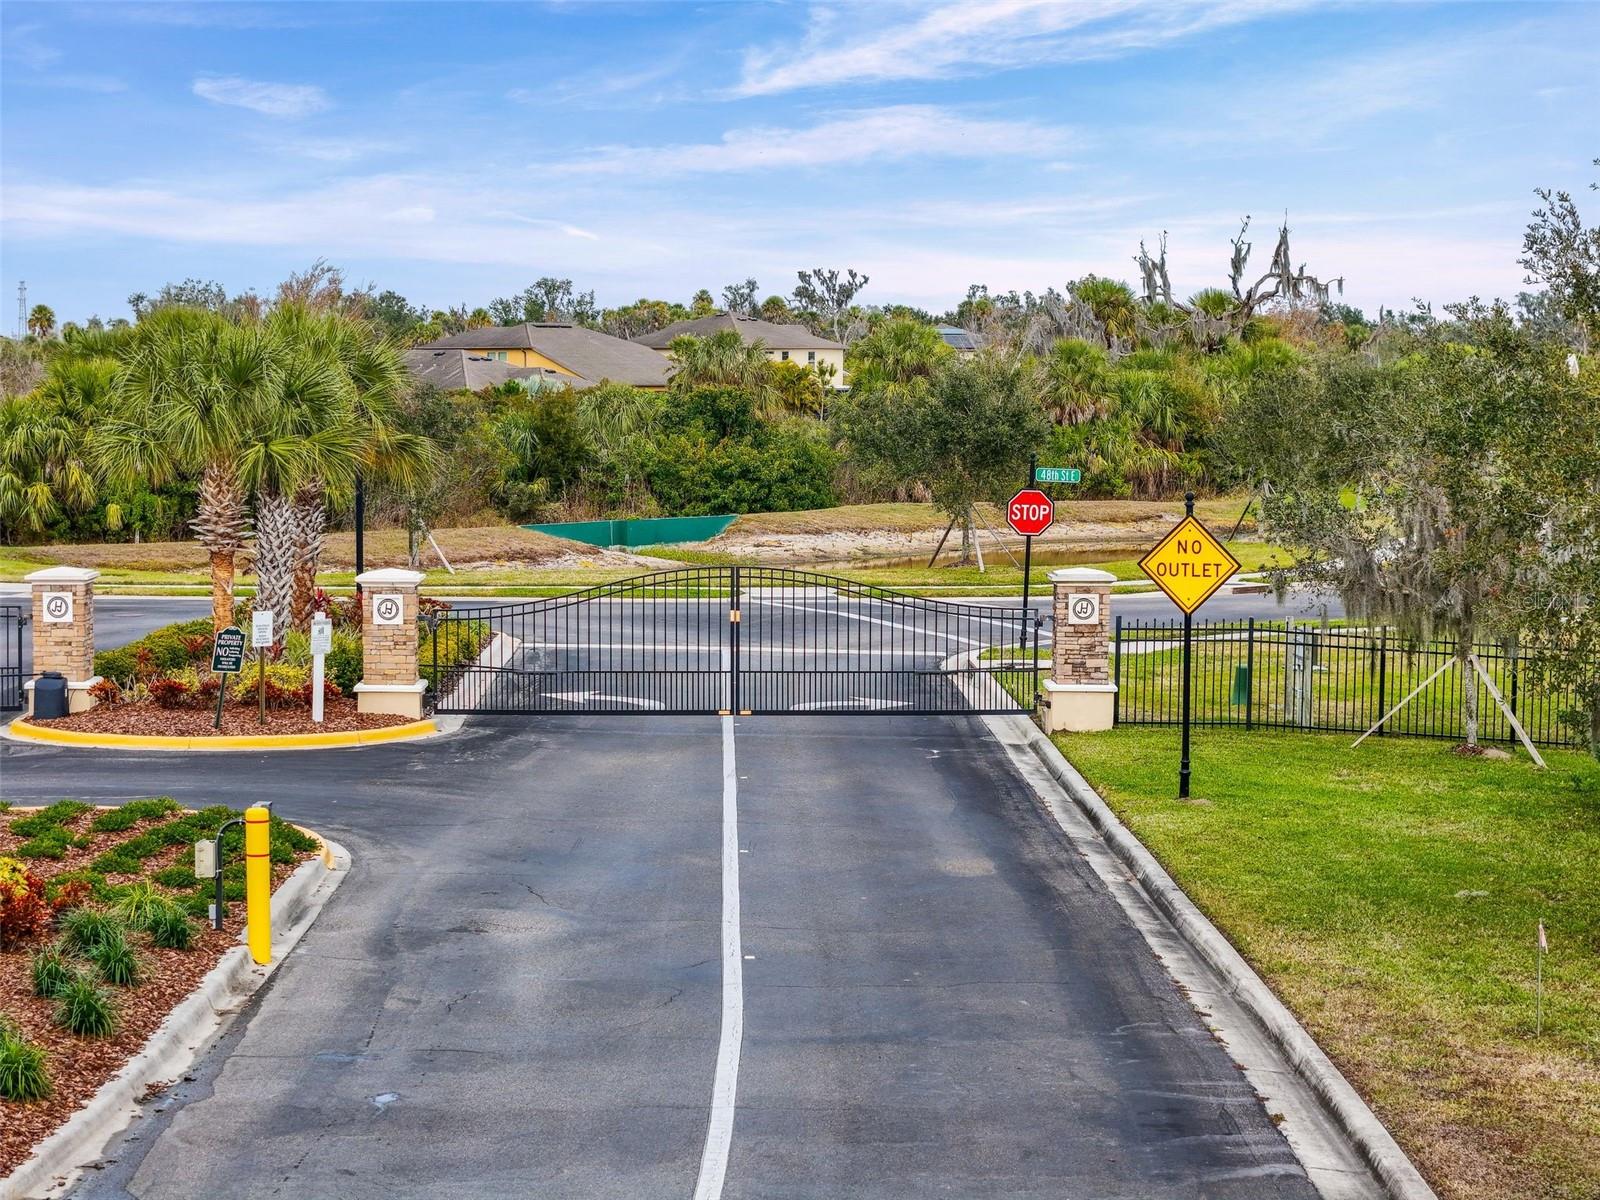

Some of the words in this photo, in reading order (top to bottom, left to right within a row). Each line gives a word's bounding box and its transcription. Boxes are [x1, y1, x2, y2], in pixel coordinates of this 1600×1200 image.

[1040, 469, 1059, 481] 48th
[1061, 470, 1069, 481] St
[1070, 470, 1076, 481] E
[1011, 504, 1050, 521] STOP
[1177, 540, 1202, 554] NO
[1156, 562, 1222, 578] OUTLET
[216, 647, 229, 656] NO
